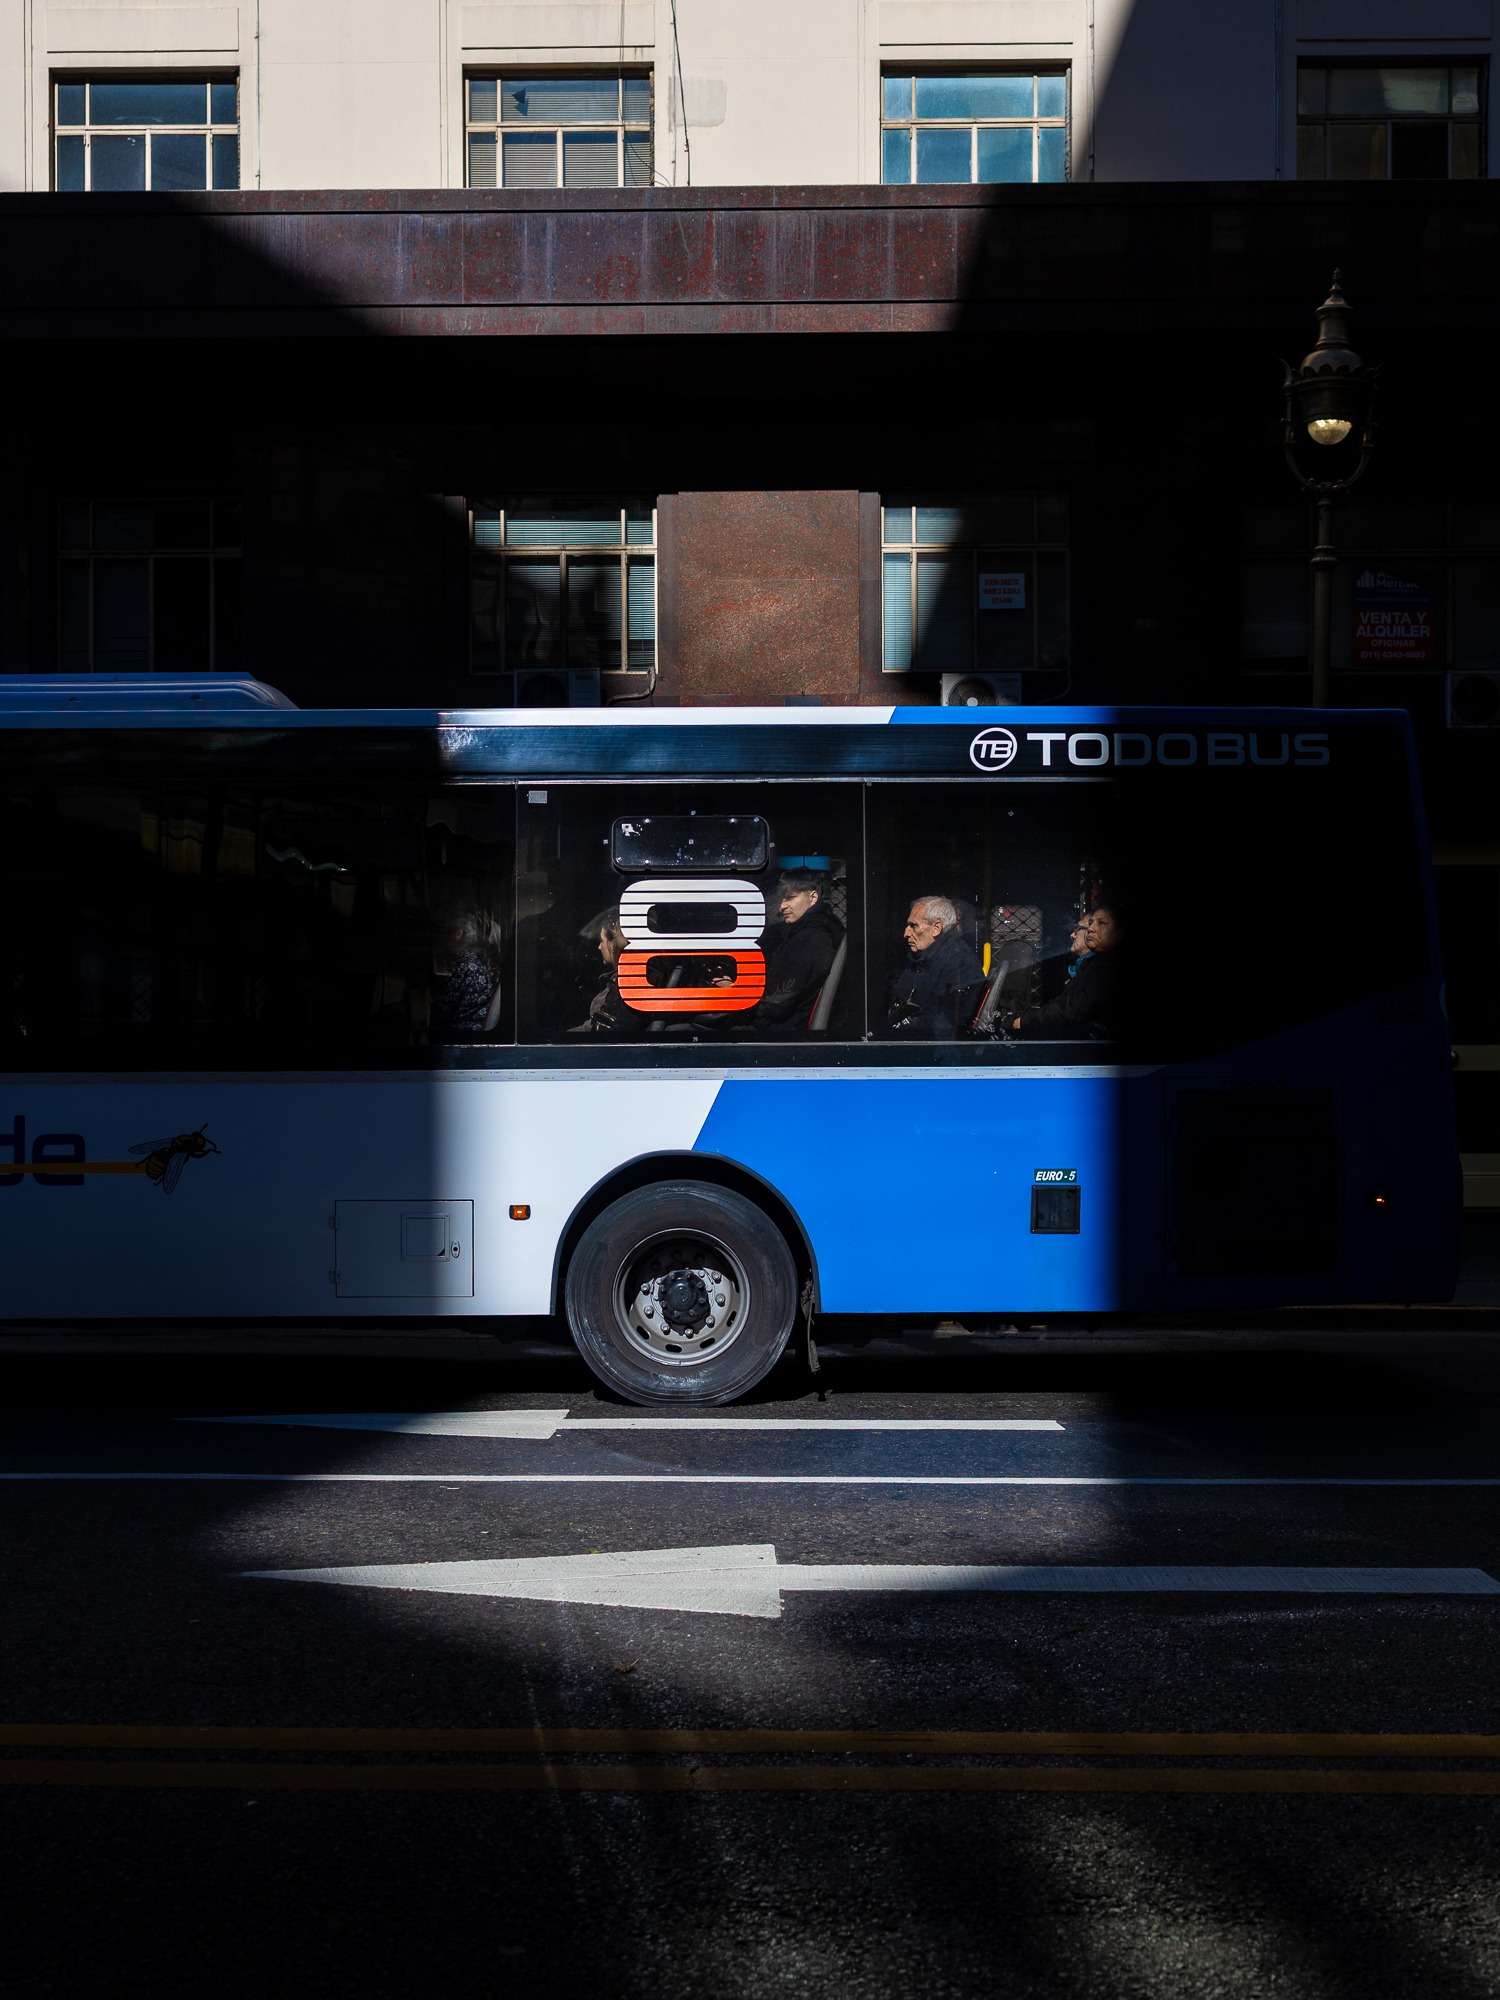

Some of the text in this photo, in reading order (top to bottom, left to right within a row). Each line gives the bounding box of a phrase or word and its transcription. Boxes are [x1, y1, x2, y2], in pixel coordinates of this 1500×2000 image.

[1002, 587, 1021, 595] ALQUILA
[1359, 611, 1428, 624] VENTA Y
[1355, 624, 1431, 638] ALQUILER
[1370, 639, 1415, 647] OFICINAS
[1360, 651, 1381, 660] (011)
[617, 879, 767, 1012] 8
